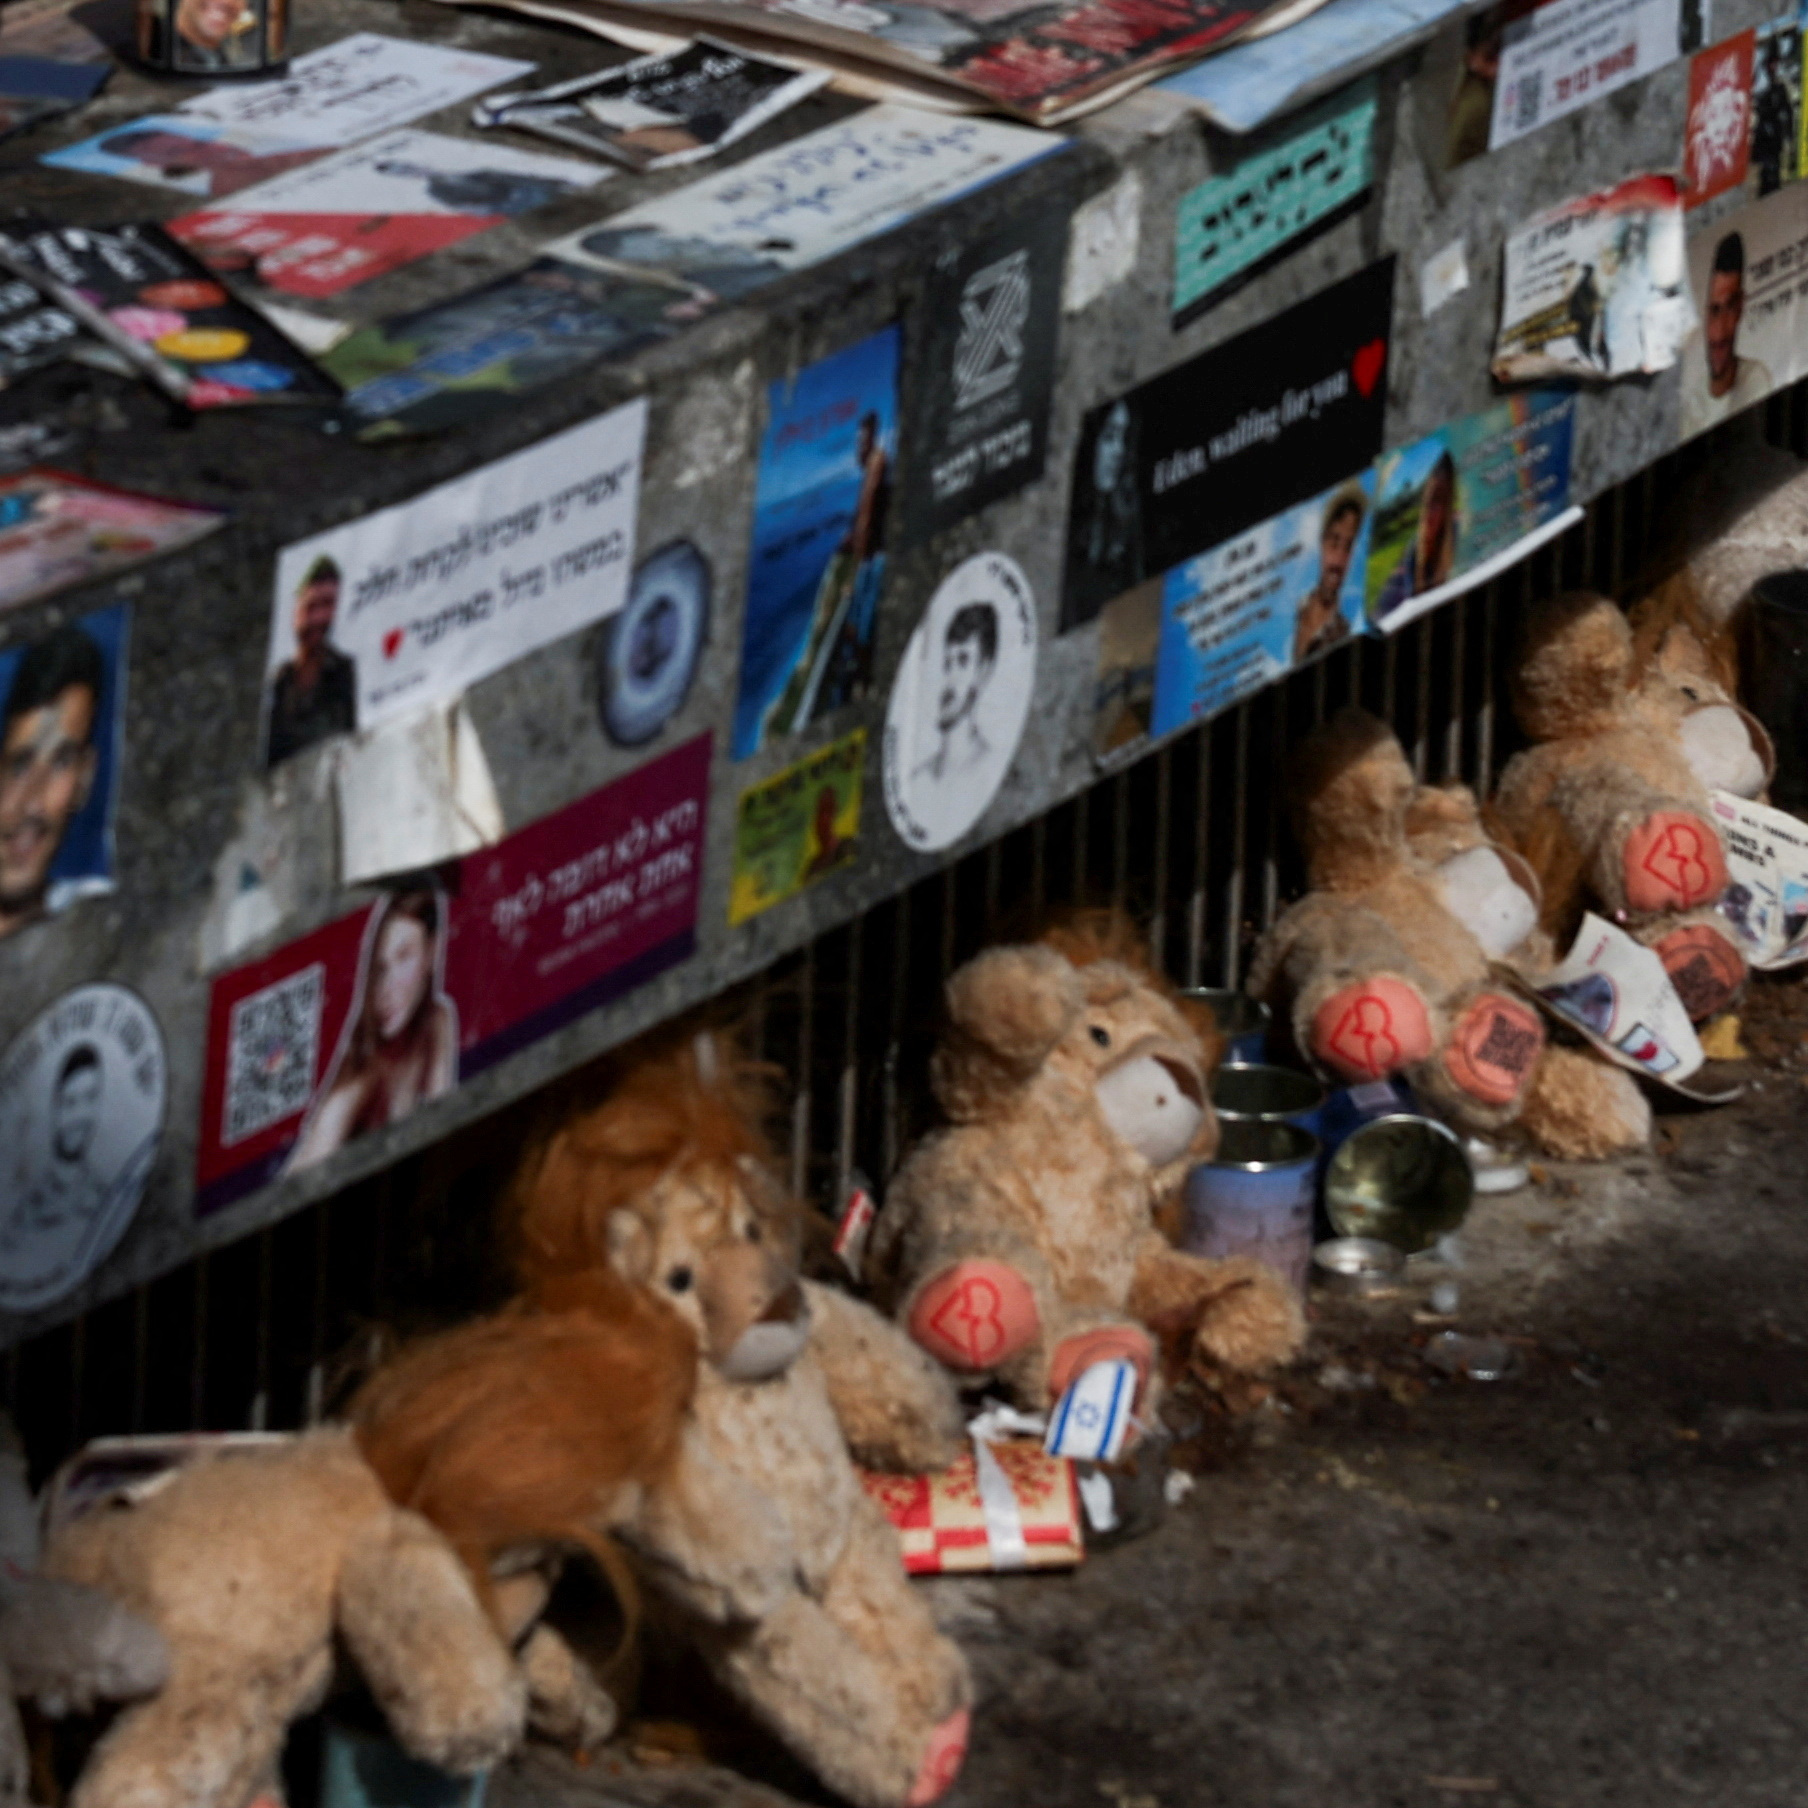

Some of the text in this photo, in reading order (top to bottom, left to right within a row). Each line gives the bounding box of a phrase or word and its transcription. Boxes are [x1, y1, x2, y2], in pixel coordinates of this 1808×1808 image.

[1205, 398, 1280, 482] waiting
[1280, 382, 1320, 432] for
[1316, 366, 1349, 420] you
